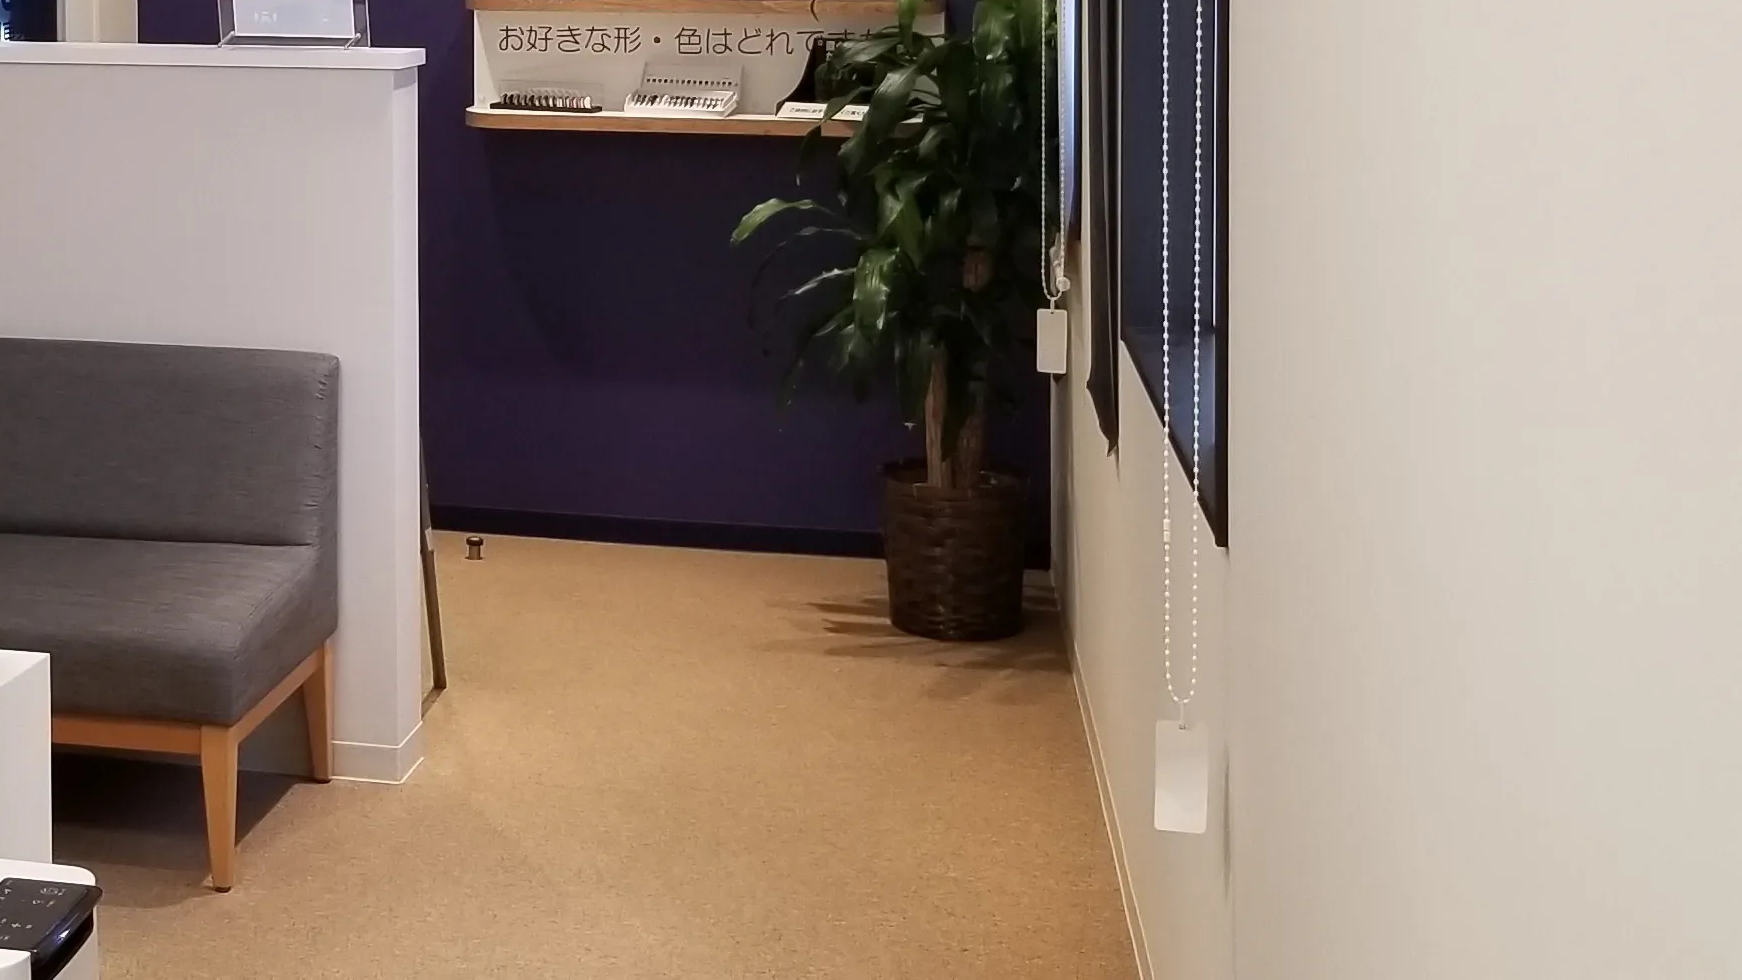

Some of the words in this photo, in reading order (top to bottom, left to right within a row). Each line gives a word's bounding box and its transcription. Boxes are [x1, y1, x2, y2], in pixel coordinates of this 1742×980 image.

[498, 23, 873, 57] お好きな形・色はどれで
